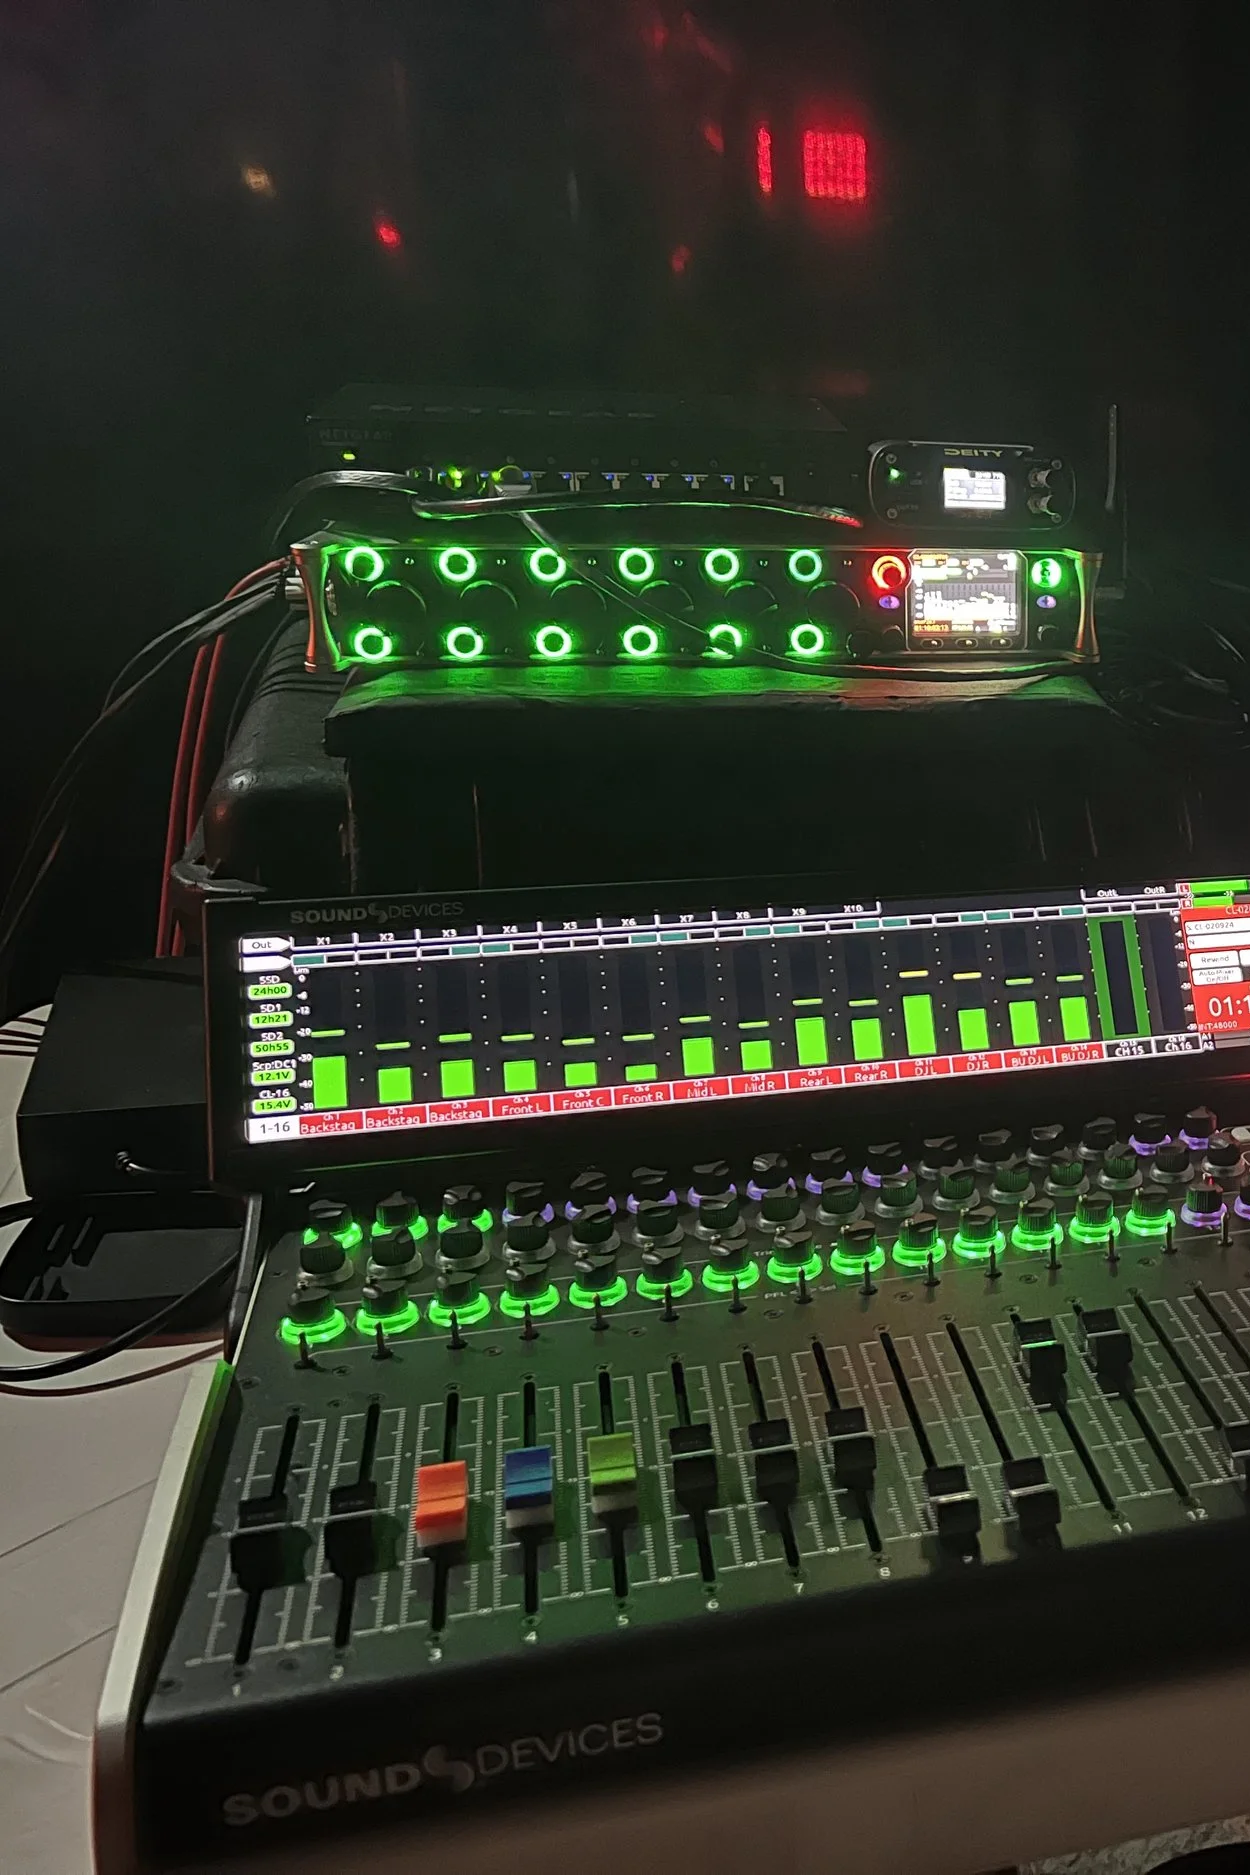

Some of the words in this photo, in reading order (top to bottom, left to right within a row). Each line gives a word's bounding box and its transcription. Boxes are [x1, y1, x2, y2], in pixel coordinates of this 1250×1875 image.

[944, 448, 1003, 457] DEITY
[290, 906, 368, 924] SOUND
[388, 902, 464, 919] DEVICES
[792, 907, 807, 916] X9
[844, 904, 863, 913] X10
[680, 914, 694, 923] X7
[736, 911, 751, 920] X8
[563, 921, 577, 930] X5
[621, 919, 636, 927] X6
[442, 929, 457, 937] X3
[502, 925, 518, 934] X4
[317, 937, 331, 945] X1
[380, 933, 394, 941] X2
[252, 941, 272, 950] Out
[259, 976, 280, 984] SSD
[254, 986, 287, 995] 24h00
[260, 1004, 281, 1012] SD1
[255, 1015, 288, 1024] 12h21
[261, 1032, 284, 1041] SD2
[255, 1043, 289, 1052] 50h55
[1115, 1046, 1131, 1056] CH
[1132, 1045, 1144, 1055] 15
[1165, 1041, 1179, 1052] Ch
[1180, 1040, 1193, 1050] 16
[1202, 1041, 1215, 1050] A2
[1011, 1056, 1026, 1067] BU
[1027, 1056, 1042, 1066] DJ
[1043, 1055, 1049, 1064] L
[1062, 1051, 1076, 1062] BU
[1077, 1051, 1091, 1061] DJ
[1091, 1050, 1099, 1059] R
[915, 1066, 930, 1077] DJ
[931, 1065, 937, 1075] L
[967, 1061, 981, 1072] DJ
[982, 1060, 990, 1069] R
[259, 1071, 290, 1081] 12.1V
[855, 1072, 879, 1082] Rear
[880, 1070, 888, 1080] R
[744, 1082, 765, 1093] Mid
[767, 1081, 775, 1091] R
[800, 1078, 825, 1088] Rear
[826, 1076, 833, 1085] L
[622, 1093, 653, 1104] Front
[655, 1091, 665, 1101] R
[687, 1087, 709, 1098] Mid
[710, 1086, 717, 1096] L
[260, 1100, 291, 1110] 15.4V
[502, 1104, 533, 1115] Front
[536, 1102, 544, 1113] L
[562, 1098, 594, 1110] Front
[596, 1097, 604, 1107] C
[260, 1122, 291, 1134] 1-16
[764, 1291, 787, 1299] PFL
[1186, 1508, 1208, 1520] 12
[1113, 1522, 1132, 1533] 11
[880, 1567, 891, 1578] 8
[793, 1582, 804, 1593] 7
[707, 1599, 720, 1610] 6
[617, 1615, 630, 1626] 5
[525, 1631, 538, 1643] 4
[222, 1764, 421, 1827] SOUND
[475, 1712, 664, 1776] DEVICES
